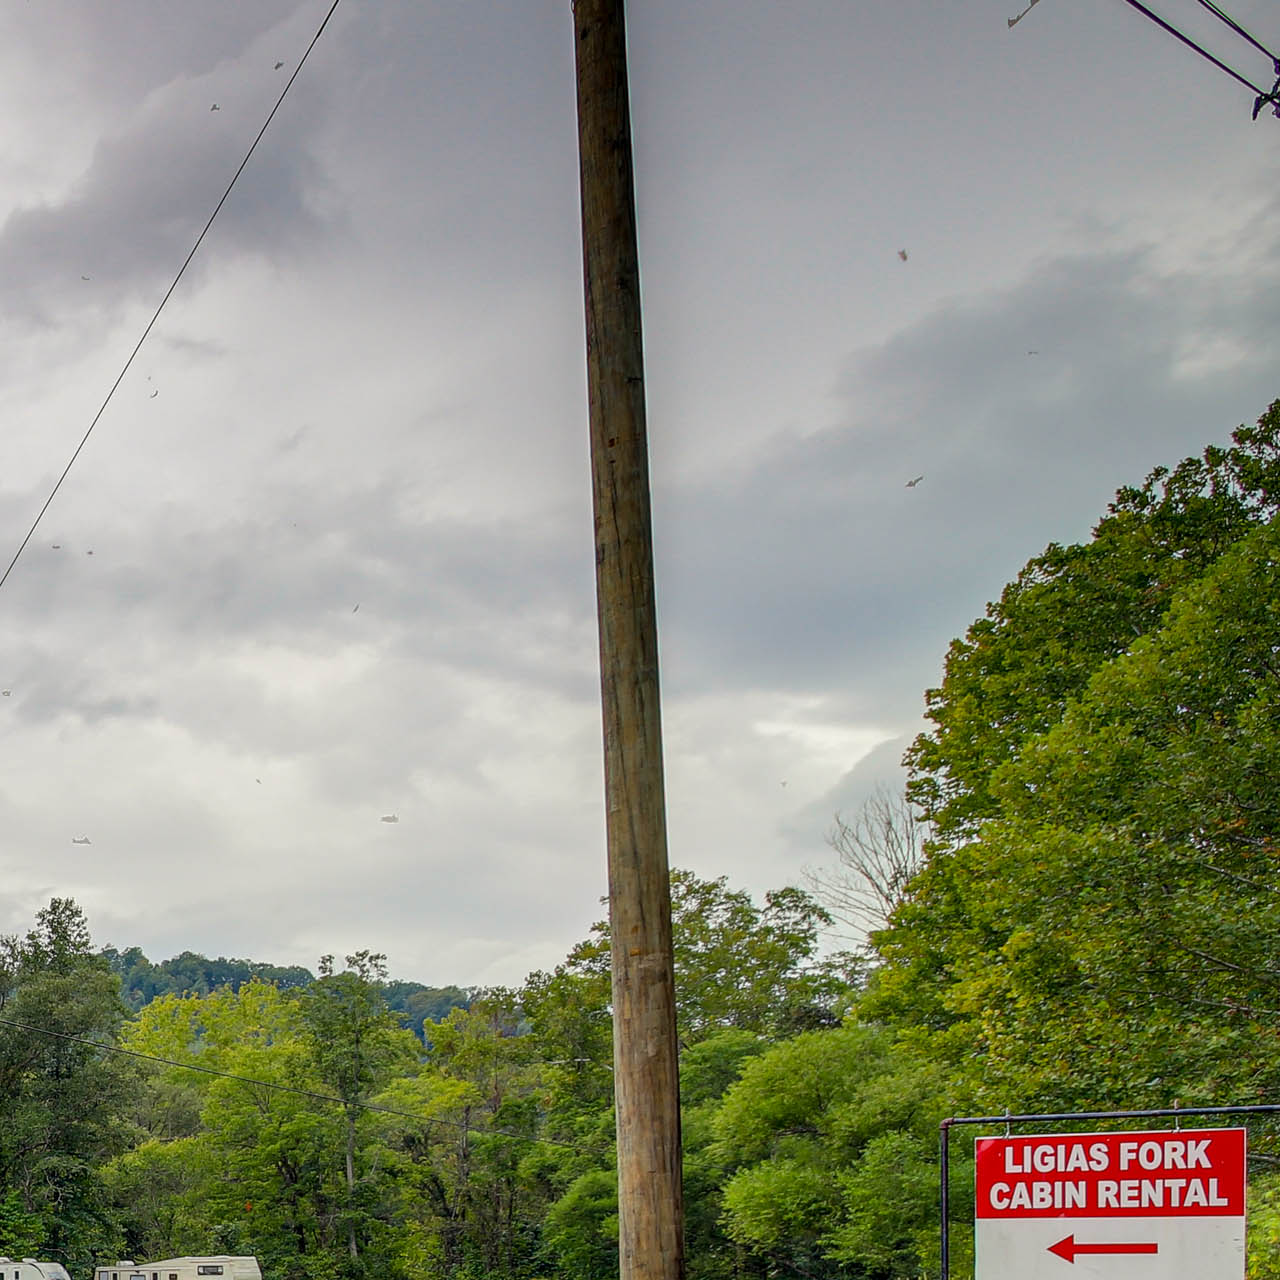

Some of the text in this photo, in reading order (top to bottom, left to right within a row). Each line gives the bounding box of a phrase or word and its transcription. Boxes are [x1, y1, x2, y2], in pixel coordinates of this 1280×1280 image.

[1004, 1139, 1212, 1174] LIGIAS FORK
[989, 1178, 1229, 1210] CABIN RENTAL
